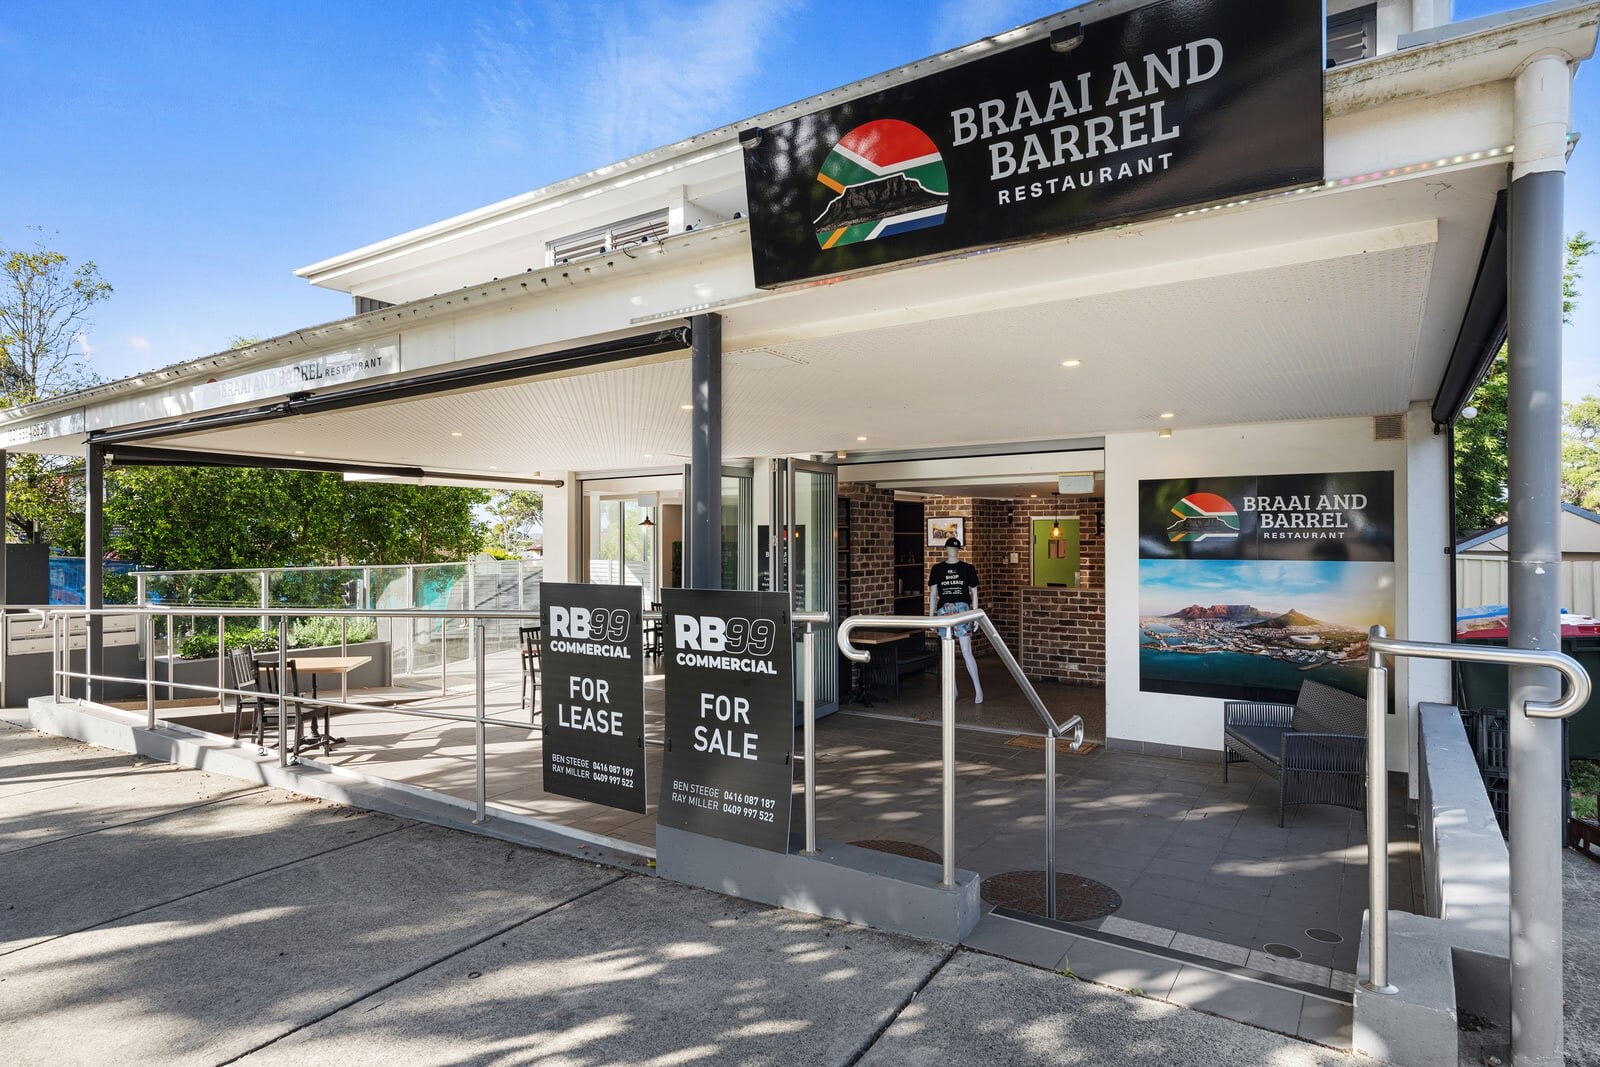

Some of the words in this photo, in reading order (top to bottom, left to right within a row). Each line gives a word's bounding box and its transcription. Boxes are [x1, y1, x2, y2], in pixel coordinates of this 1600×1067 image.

[951, 71, 1092, 147] BRAAI
[1105, 37, 1224, 107] AND
[988, 100, 1180, 181] BARREL
[998, 152, 1173, 205] RESTAURANT
[279, 363, 323, 387] BARREL
[1243, 495, 1311, 512] BRAAI
[1316, 494, 1368, 511] AND
[1260, 512, 1348, 529] BARREL
[550, 605, 631, 643] RB99
[674, 614, 776, 657] RB99
[550, 640, 631, 659] COMMERCIAL
[676, 652, 778, 675] COMMERCIAL
[569, 675, 610, 704] FOR
[558, 703, 624, 737] LEASE
[700, 692, 750, 725] FOR
[693, 725, 759, 761] SALE
[552, 753, 565, 763] BEN
[565, 756, 590, 769] STEEGE
[592, 761, 608, 772] 0416
[608, 765, 621, 774] 087
[621, 767, 634, 777] 187
[552, 764, 565, 774] RAY
[565, 766, 590, 779] MILLER
[592, 772, 608, 783] 0409
[608, 776, 621, 786] 997
[621, 778, 634, 788] 522
[671, 792, 687, 804] RAY
[688, 795, 719, 811] MILLER
[722, 803, 742, 815] 0409
[743, 807, 758, 819] 997
[759, 811, 774, 823] 522
[673, 780, 689, 792] BEN
[690, 784, 720, 798] STEEGE
[723, 790, 743, 803] 0416
[744, 795, 759, 806] 087
[760, 798, 776, 810] 187
